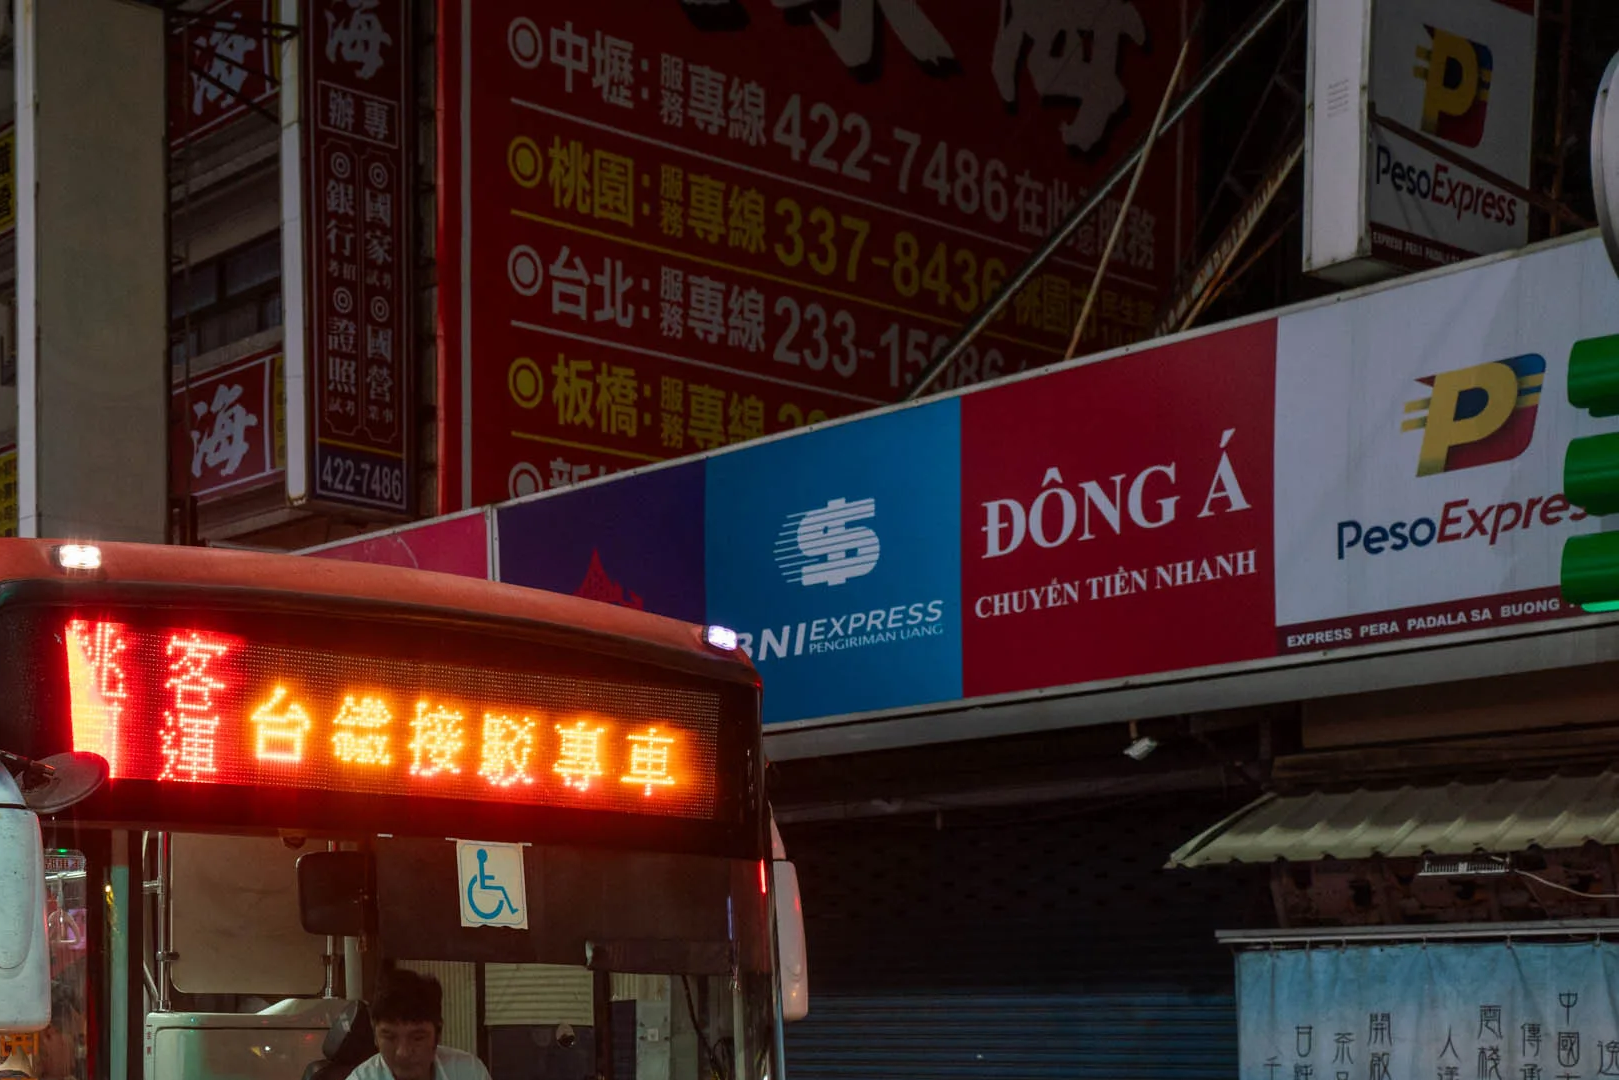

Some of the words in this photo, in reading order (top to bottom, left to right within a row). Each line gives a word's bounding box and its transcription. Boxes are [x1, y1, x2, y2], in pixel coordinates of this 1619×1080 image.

[1376, 144, 1516, 225] PesoExpress
[191, 384, 258, 477] 海
[321, 455, 402, 502] 422-7486
[981, 461, 1180, 560] ĐÔNG
[1196, 428, 1252, 518] Á
[1154, 549, 1257, 590] NHANH
[809, 631, 896, 654] PENGIRIMAN
[901, 623, 944, 642] UANG
[810, 600, 943, 641] EXPRESS
[1287, 628, 1353, 648] EXPRESS
[1360, 622, 1400, 637] PERA
[1407, 612, 1467, 632] PADALA
[1470, 609, 1492, 622] SA
[1501, 599, 1560, 618] BUONG
